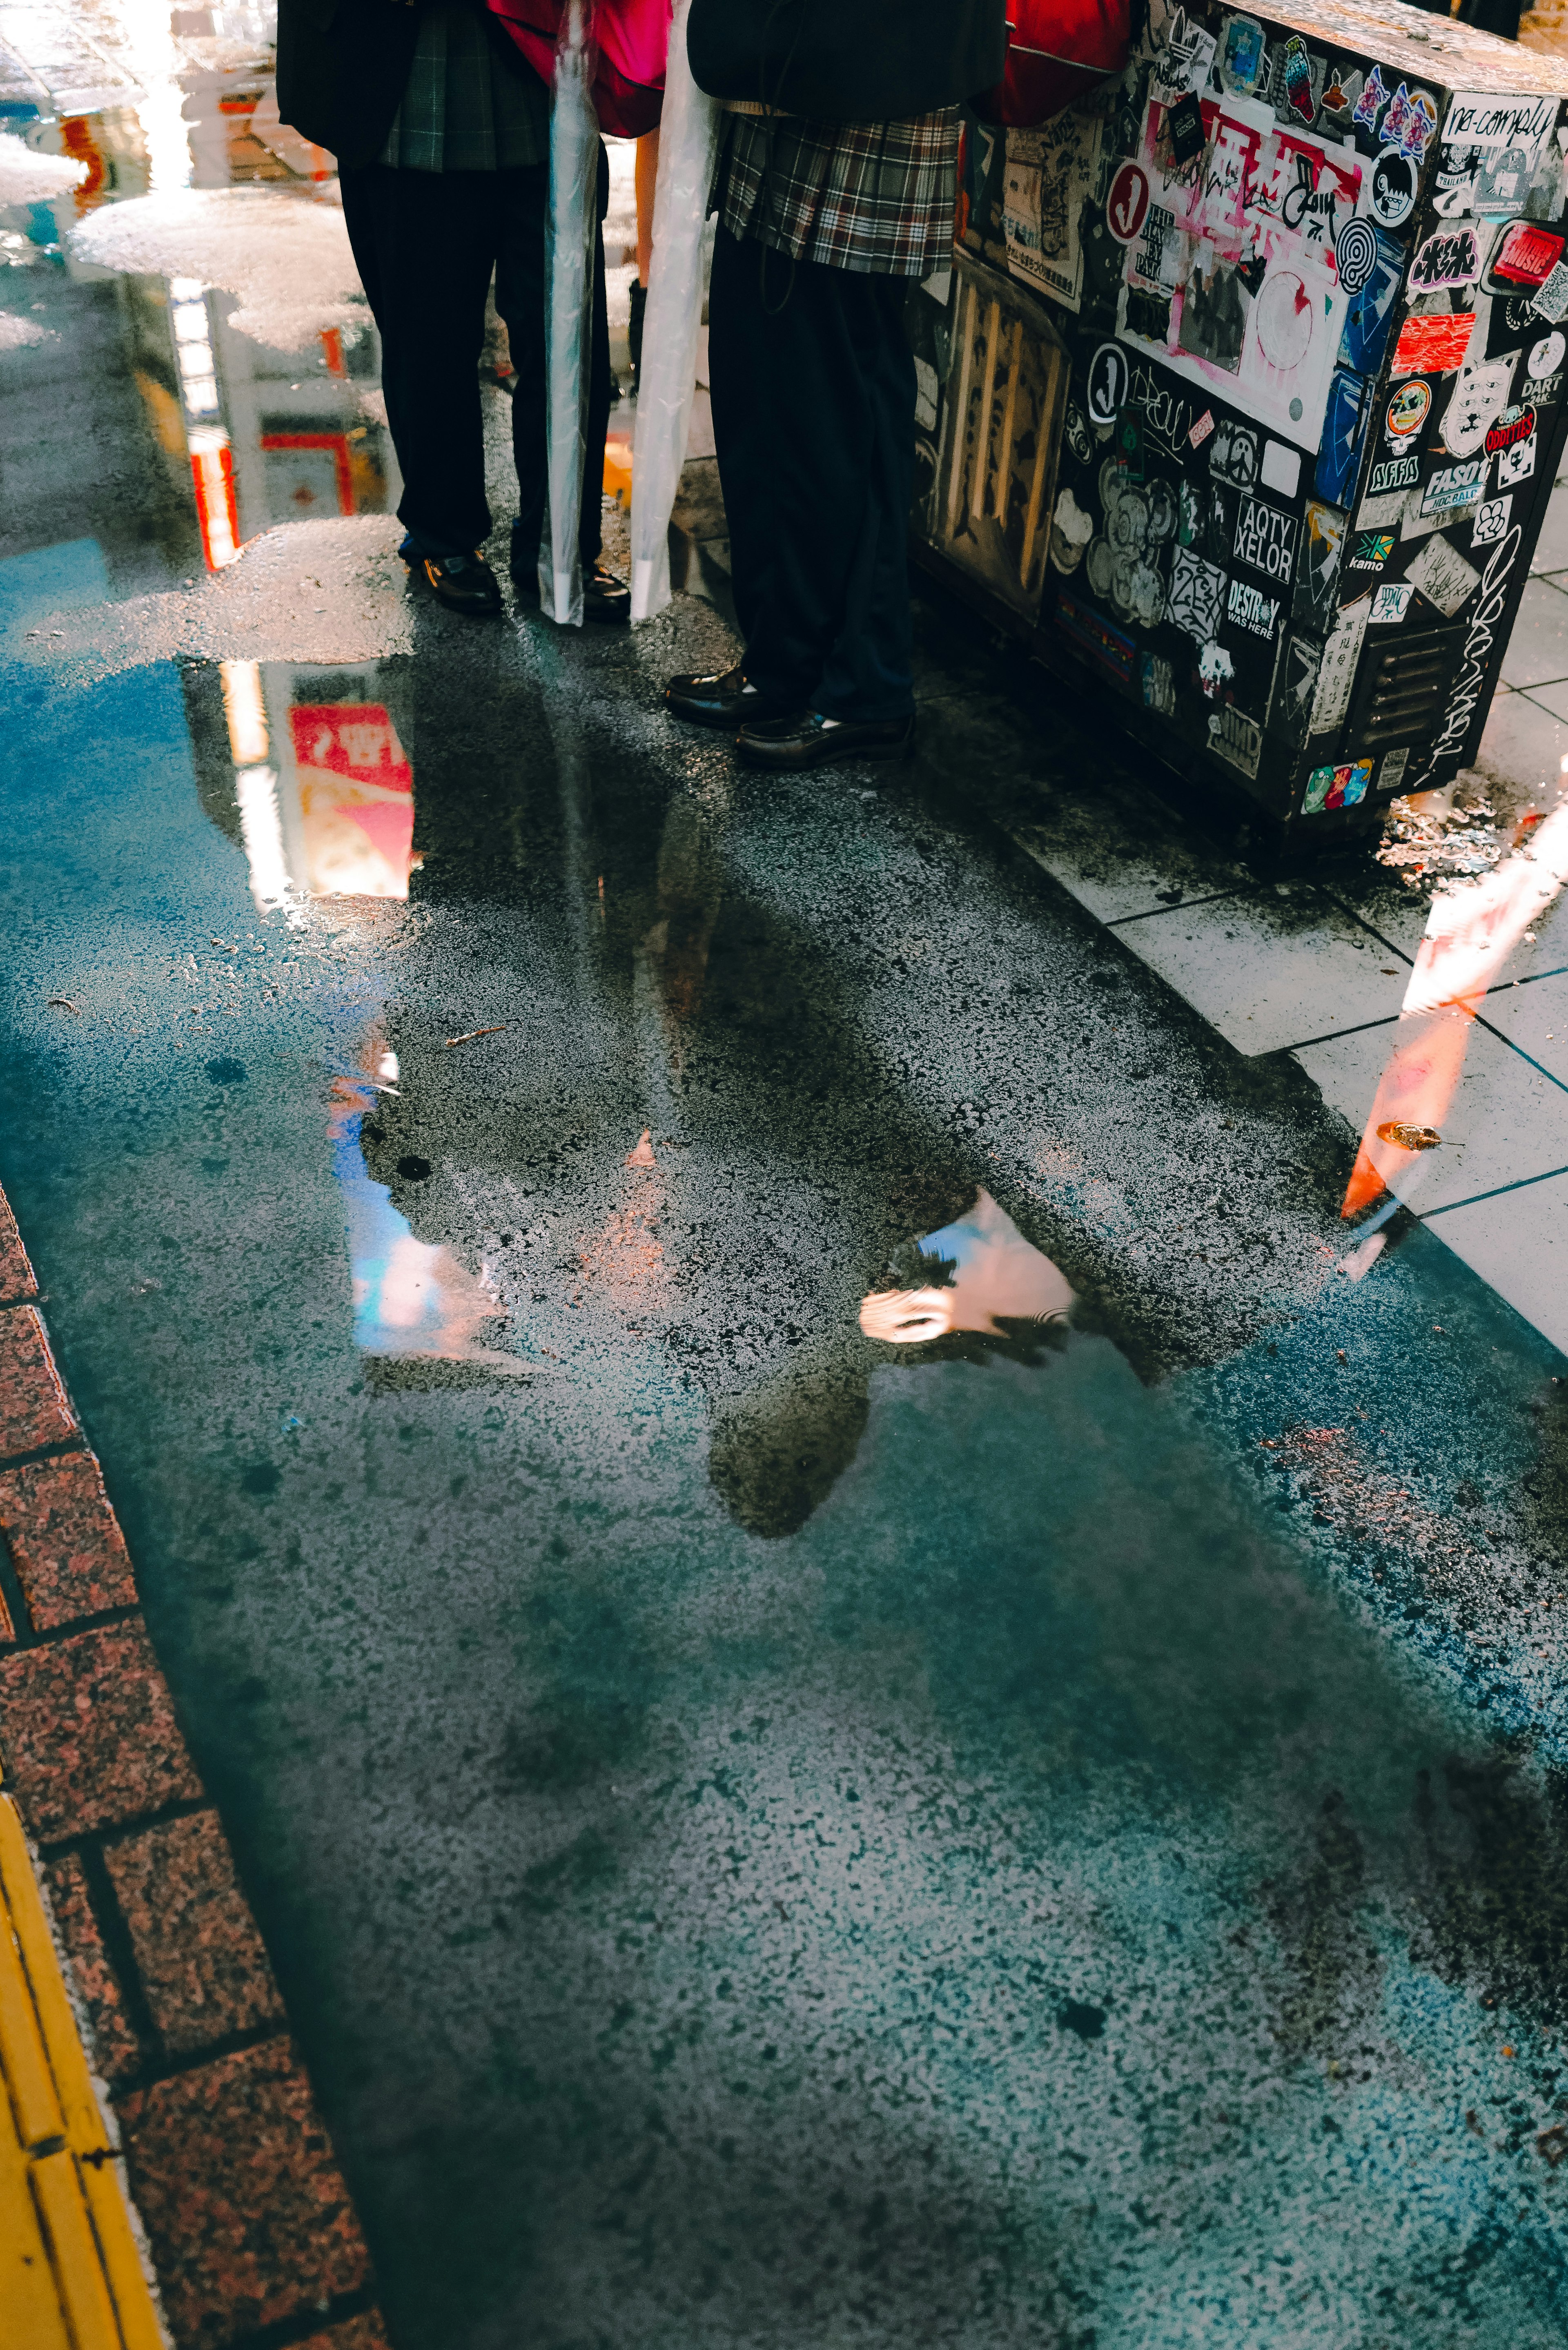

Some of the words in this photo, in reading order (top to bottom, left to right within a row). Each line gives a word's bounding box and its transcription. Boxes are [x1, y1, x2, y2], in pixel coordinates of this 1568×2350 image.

[1439, 175, 1467, 185] THAILAND
[1505, 252, 1547, 274] MUSIC
[1521, 376, 1563, 398] DART
[1487, 413, 1534, 452] ODDITIES
[1370, 456, 1419, 492] AFFA
[1244, 502, 1291, 548] AQTY
[1234, 526, 1292, 581] XELOR
[1349, 557, 1384, 572] kamo
[1228, 611, 1247, 628] WAS
[1248, 622, 1274, 640] HERE
